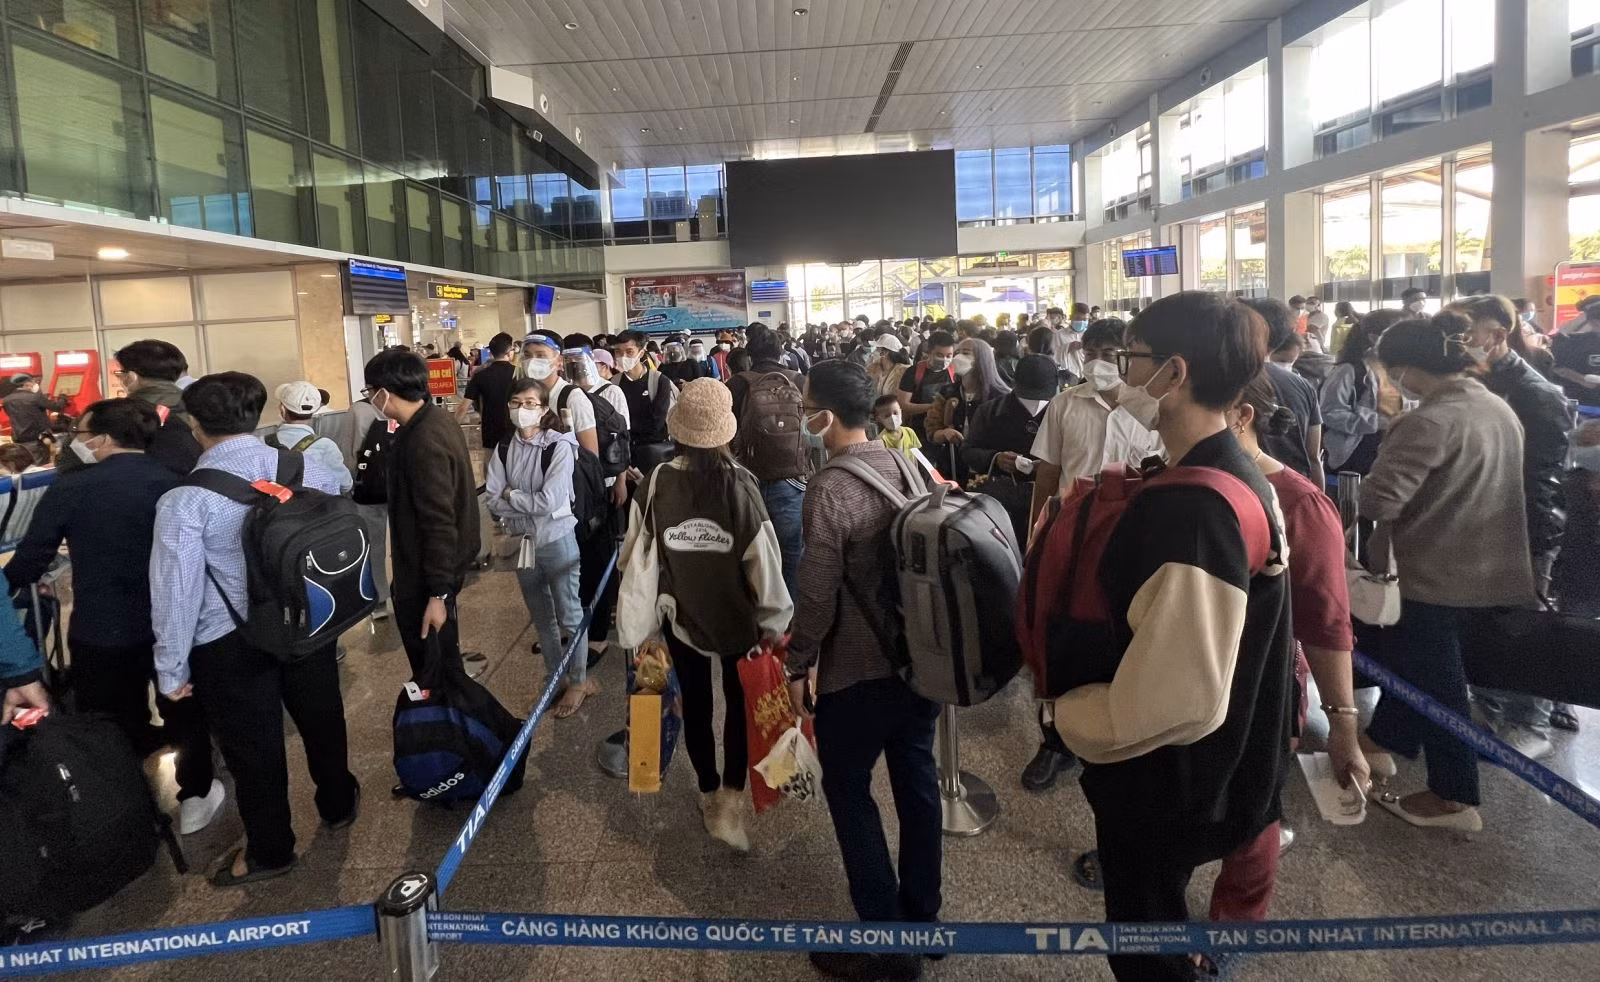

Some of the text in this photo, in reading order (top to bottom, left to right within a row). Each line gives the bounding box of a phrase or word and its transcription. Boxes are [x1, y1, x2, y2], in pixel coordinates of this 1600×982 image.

[668, 531, 697, 541] Yellow
[419, 772, 465, 799] adidas
[456, 804, 486, 853] TIA
[427, 923, 489, 931] NTERNATIONAL
[502, 916, 958, 946] CẢNG HÀNG KHÔNG QUỐC TẾ TÂN SƠN NHẤT
[1025, 928, 1110, 950] TIA
[1118, 935, 1192, 943] INTERNATIONAL
[1206, 929, 1250, 946] TAN
[1255, 928, 1301, 945] SON
[1308, 927, 1368, 944] NHAT
[1373, 918, 1554, 941] INTERNATIONAL
[11, 949, 63, 967] NHAT
[68, 931, 223, 961] INTERNATIONAL
[227, 920, 311, 944] AIRPORT
